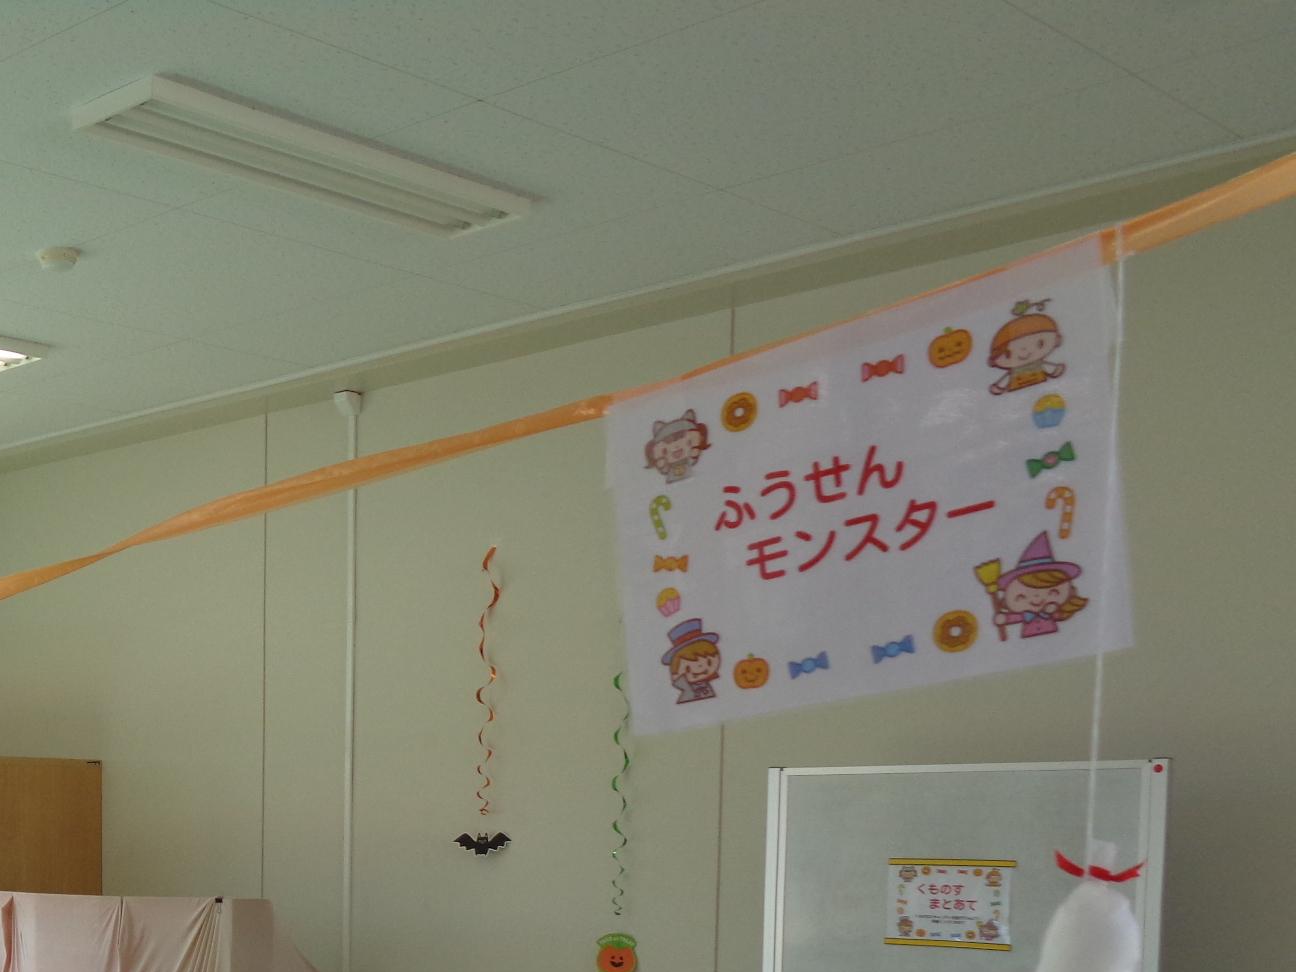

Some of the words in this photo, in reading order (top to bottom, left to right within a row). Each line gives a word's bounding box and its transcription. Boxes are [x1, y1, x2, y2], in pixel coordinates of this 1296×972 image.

[715, 444, 904, 531] ふうせん
[745, 499, 995, 581] モンスター
[916, 883, 965, 896] くものす
[928, 898, 979, 911] まとあて
